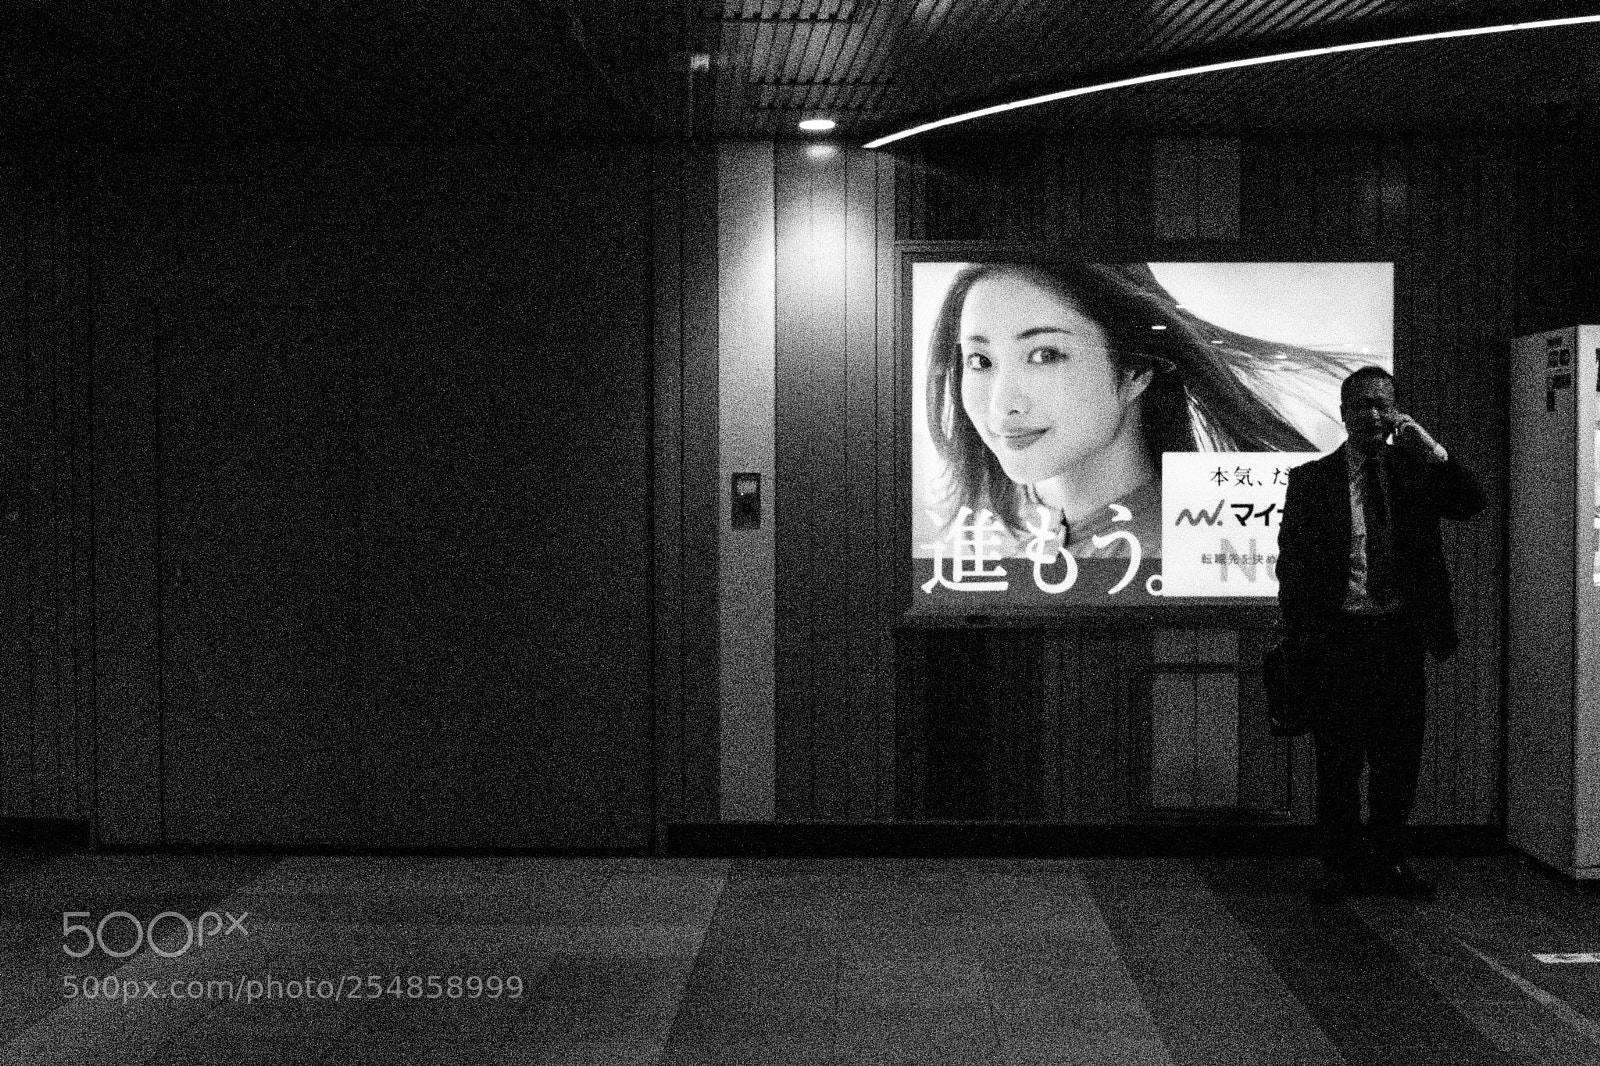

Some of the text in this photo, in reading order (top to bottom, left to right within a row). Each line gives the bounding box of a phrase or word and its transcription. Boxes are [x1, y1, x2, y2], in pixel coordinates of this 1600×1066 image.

[1230, 503, 1284, 527] マイ
[920, 504, 1163, 596] 進もう。
